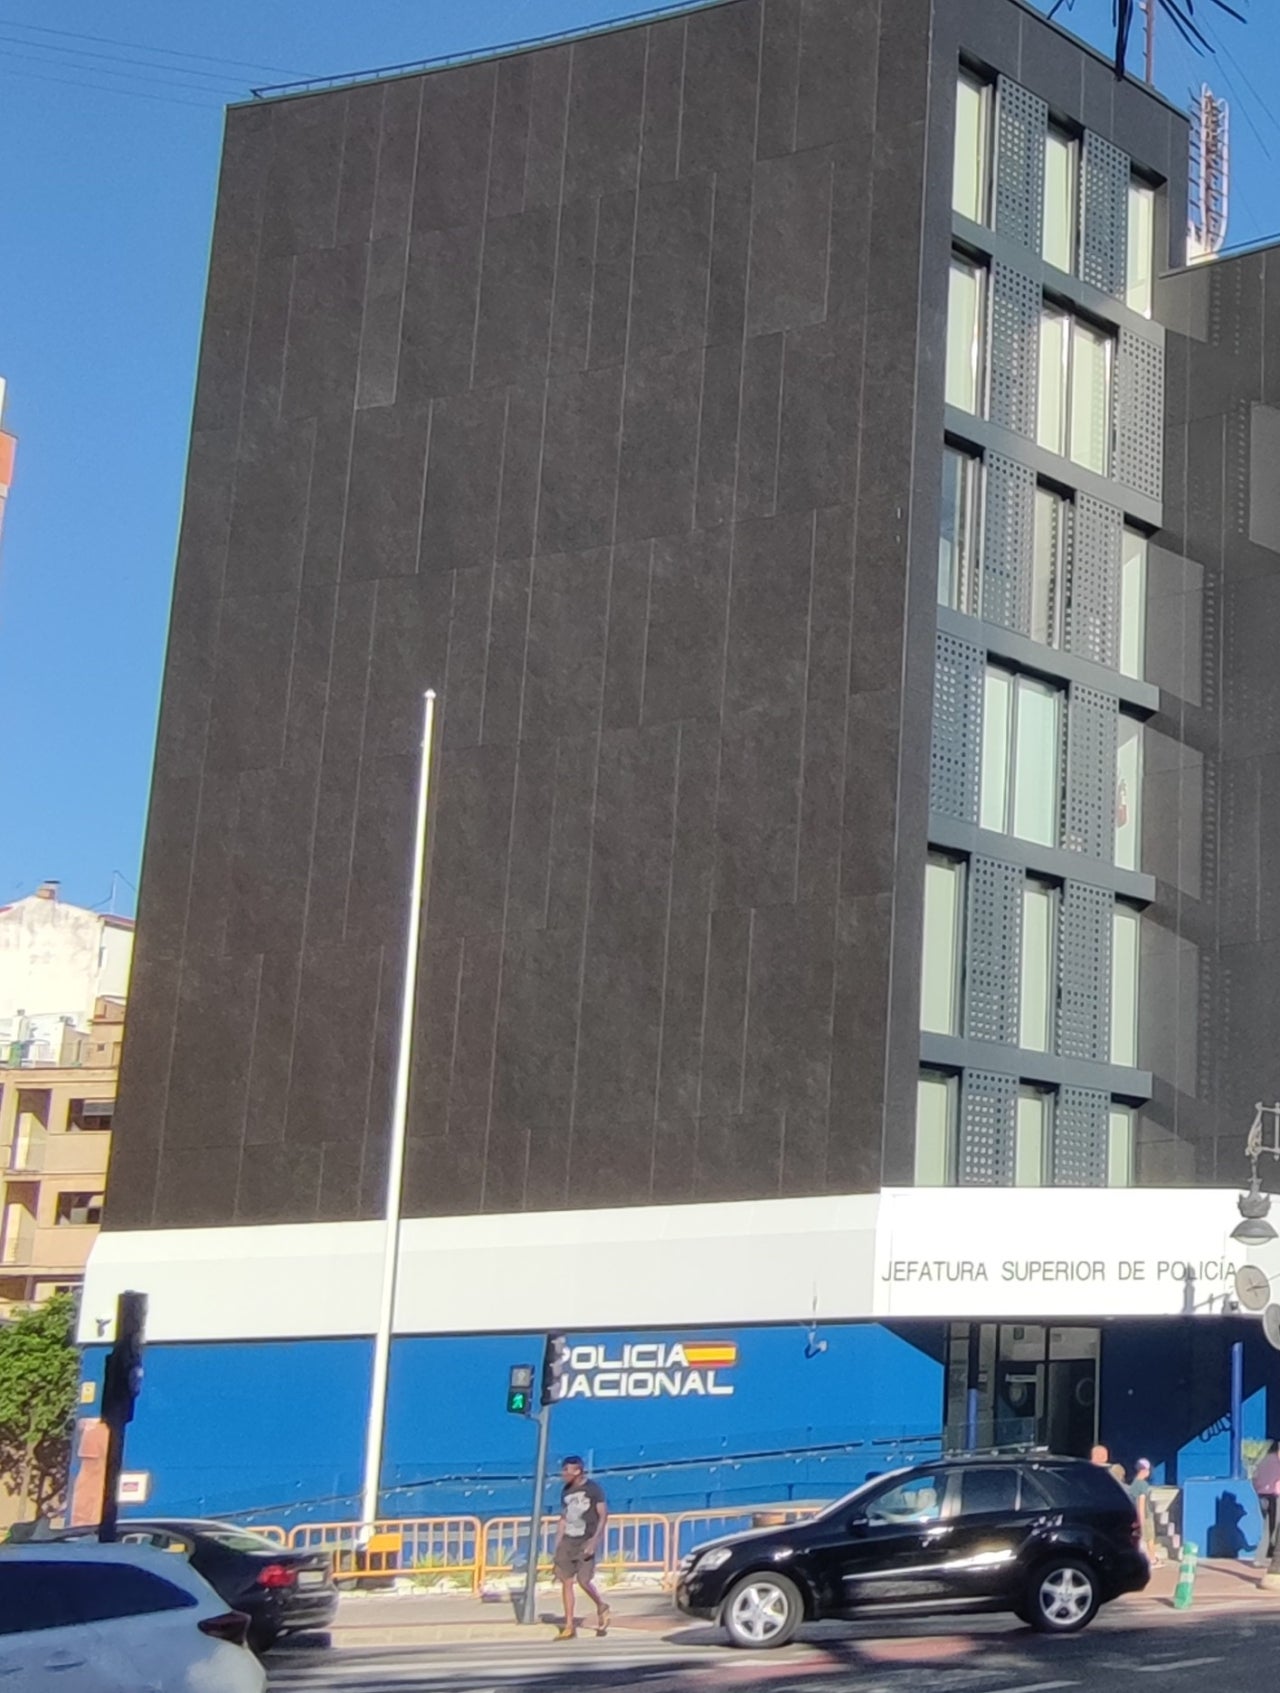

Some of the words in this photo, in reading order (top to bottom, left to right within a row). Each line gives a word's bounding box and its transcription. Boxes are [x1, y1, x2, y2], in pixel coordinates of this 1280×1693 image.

[881, 1260, 988, 1282] JEFATURA
[1001, 1260, 1106, 1282] SUPERIOR
[1118, 1260, 1145, 1281] DE
[1157, 1256, 1237, 1282] POLICÍA
